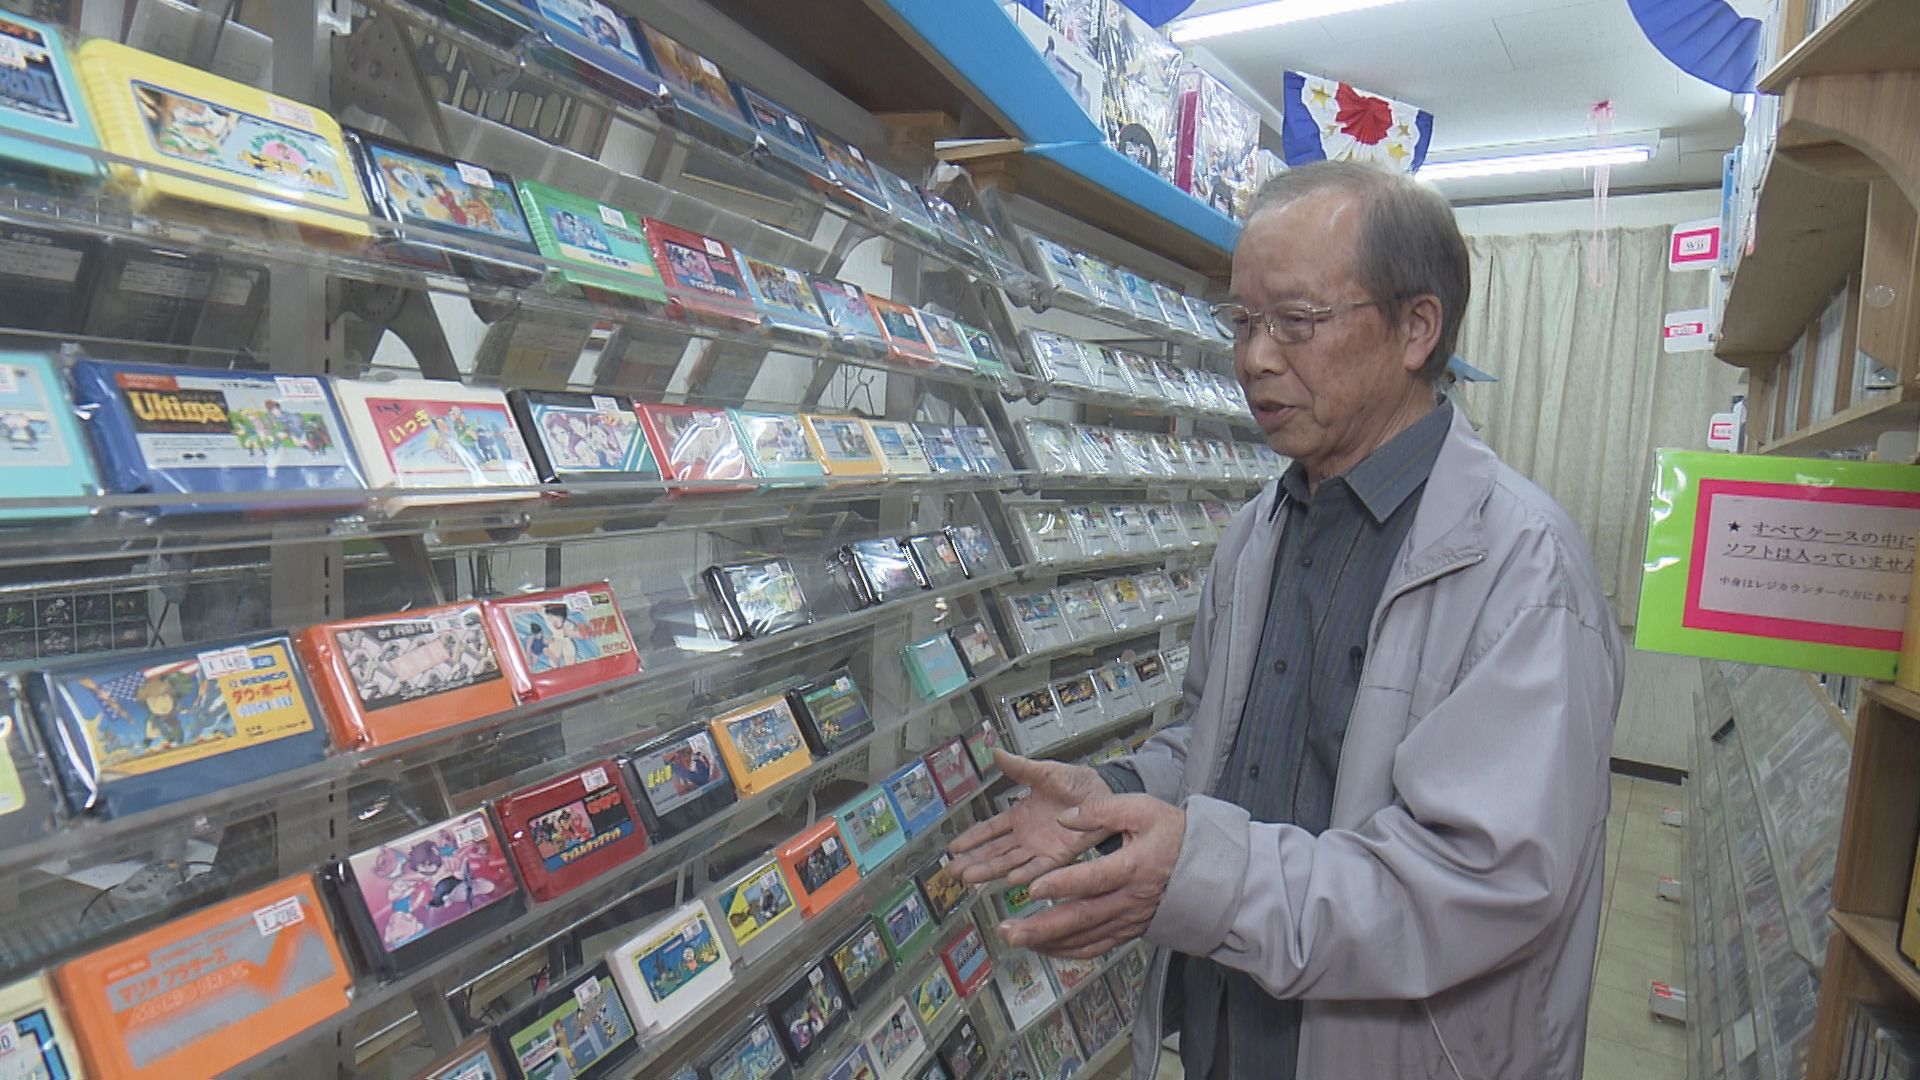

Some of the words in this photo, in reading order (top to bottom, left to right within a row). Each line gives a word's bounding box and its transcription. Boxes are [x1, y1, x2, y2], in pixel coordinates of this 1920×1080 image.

[127, 391, 229, 424] Ultima
[1752, 521, 1915, 549] すべてケースの中に
